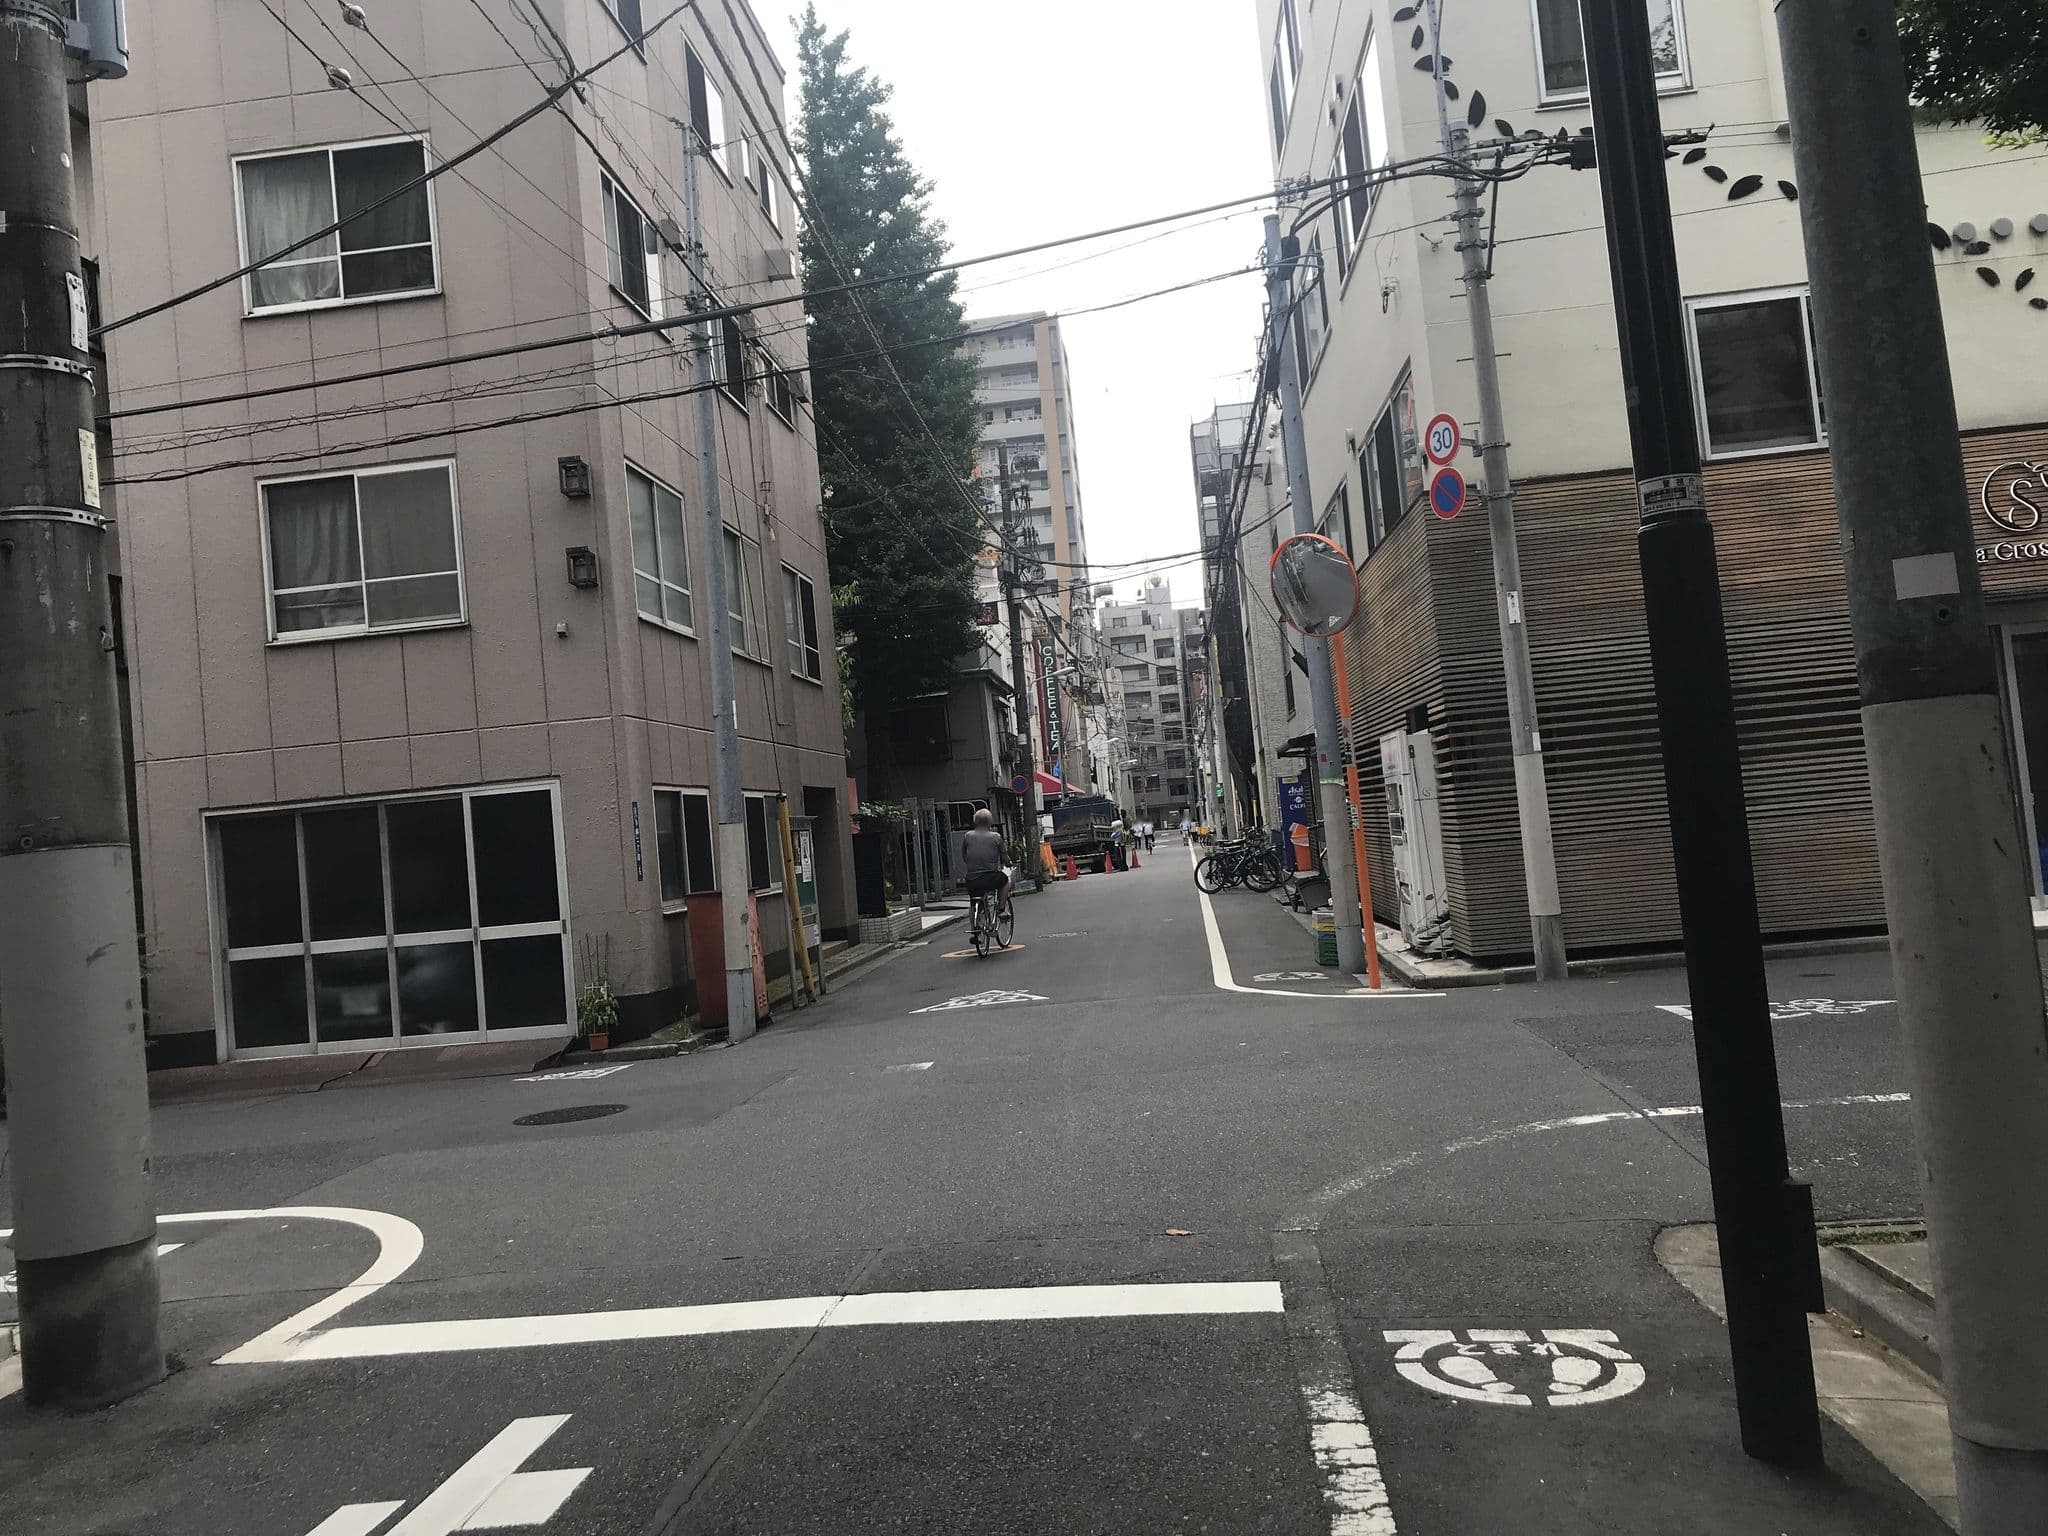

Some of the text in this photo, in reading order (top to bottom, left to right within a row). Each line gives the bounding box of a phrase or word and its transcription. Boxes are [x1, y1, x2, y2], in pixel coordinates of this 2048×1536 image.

[1432, 426, 1453, 453] 30
[1042, 646, 1060, 751] COFFEE & TEA
[1452, 1342, 1565, 1356] とまれ
